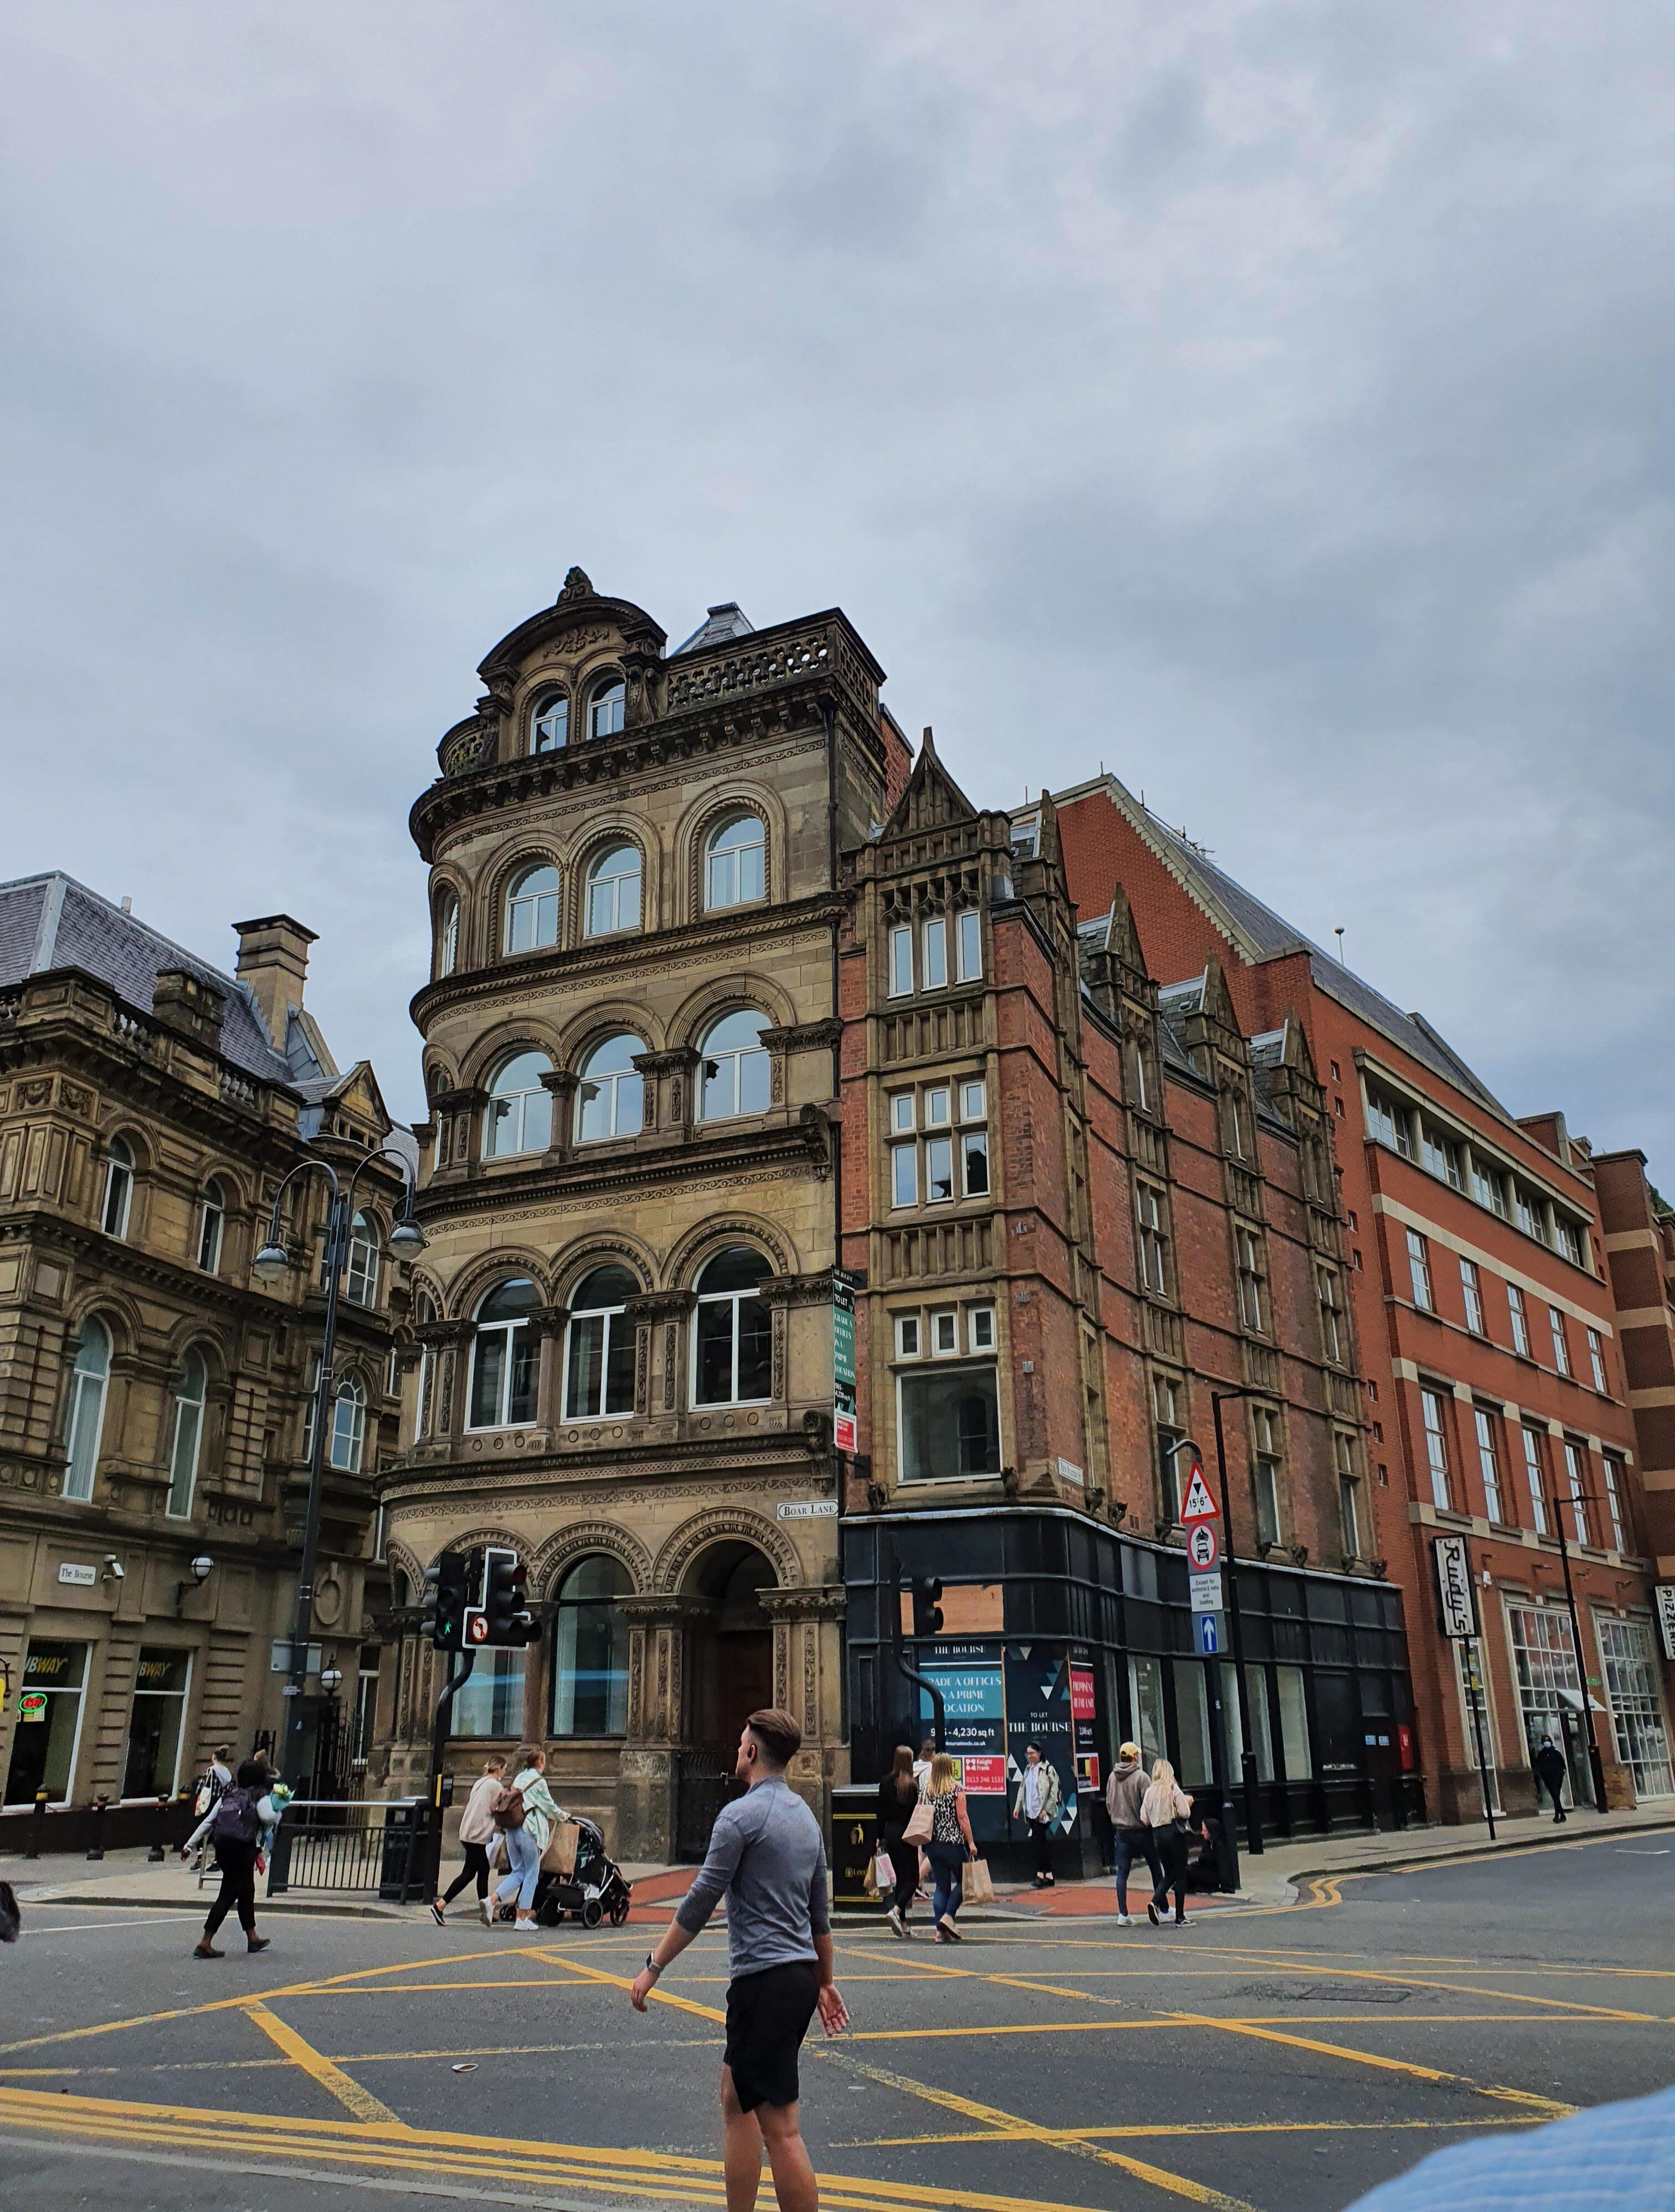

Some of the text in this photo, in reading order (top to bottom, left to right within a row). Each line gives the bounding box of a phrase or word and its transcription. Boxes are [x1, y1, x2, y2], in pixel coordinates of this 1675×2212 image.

[835, 1294, 840, 1303] TO
[784, 1504, 834, 1516] BOAR LANE
[61, 1568, 93, 1580] The Bourse
[1444, 1541, 1467, 1632] Rudy's
[935, 1645, 985, 1654] THE BOURSE
[928, 1676, 1001, 1686] RADE A OFFICES
[948, 1690, 955, 1699] A
[957, 1690, 985, 1699] PRIME
[943, 1704, 985, 1712] OCATION
[953, 1727, 977, 1737] 4,230
[1009, 1722, 1028, 1732] THE
[1031, 1722, 1071, 1732] BOURSE
